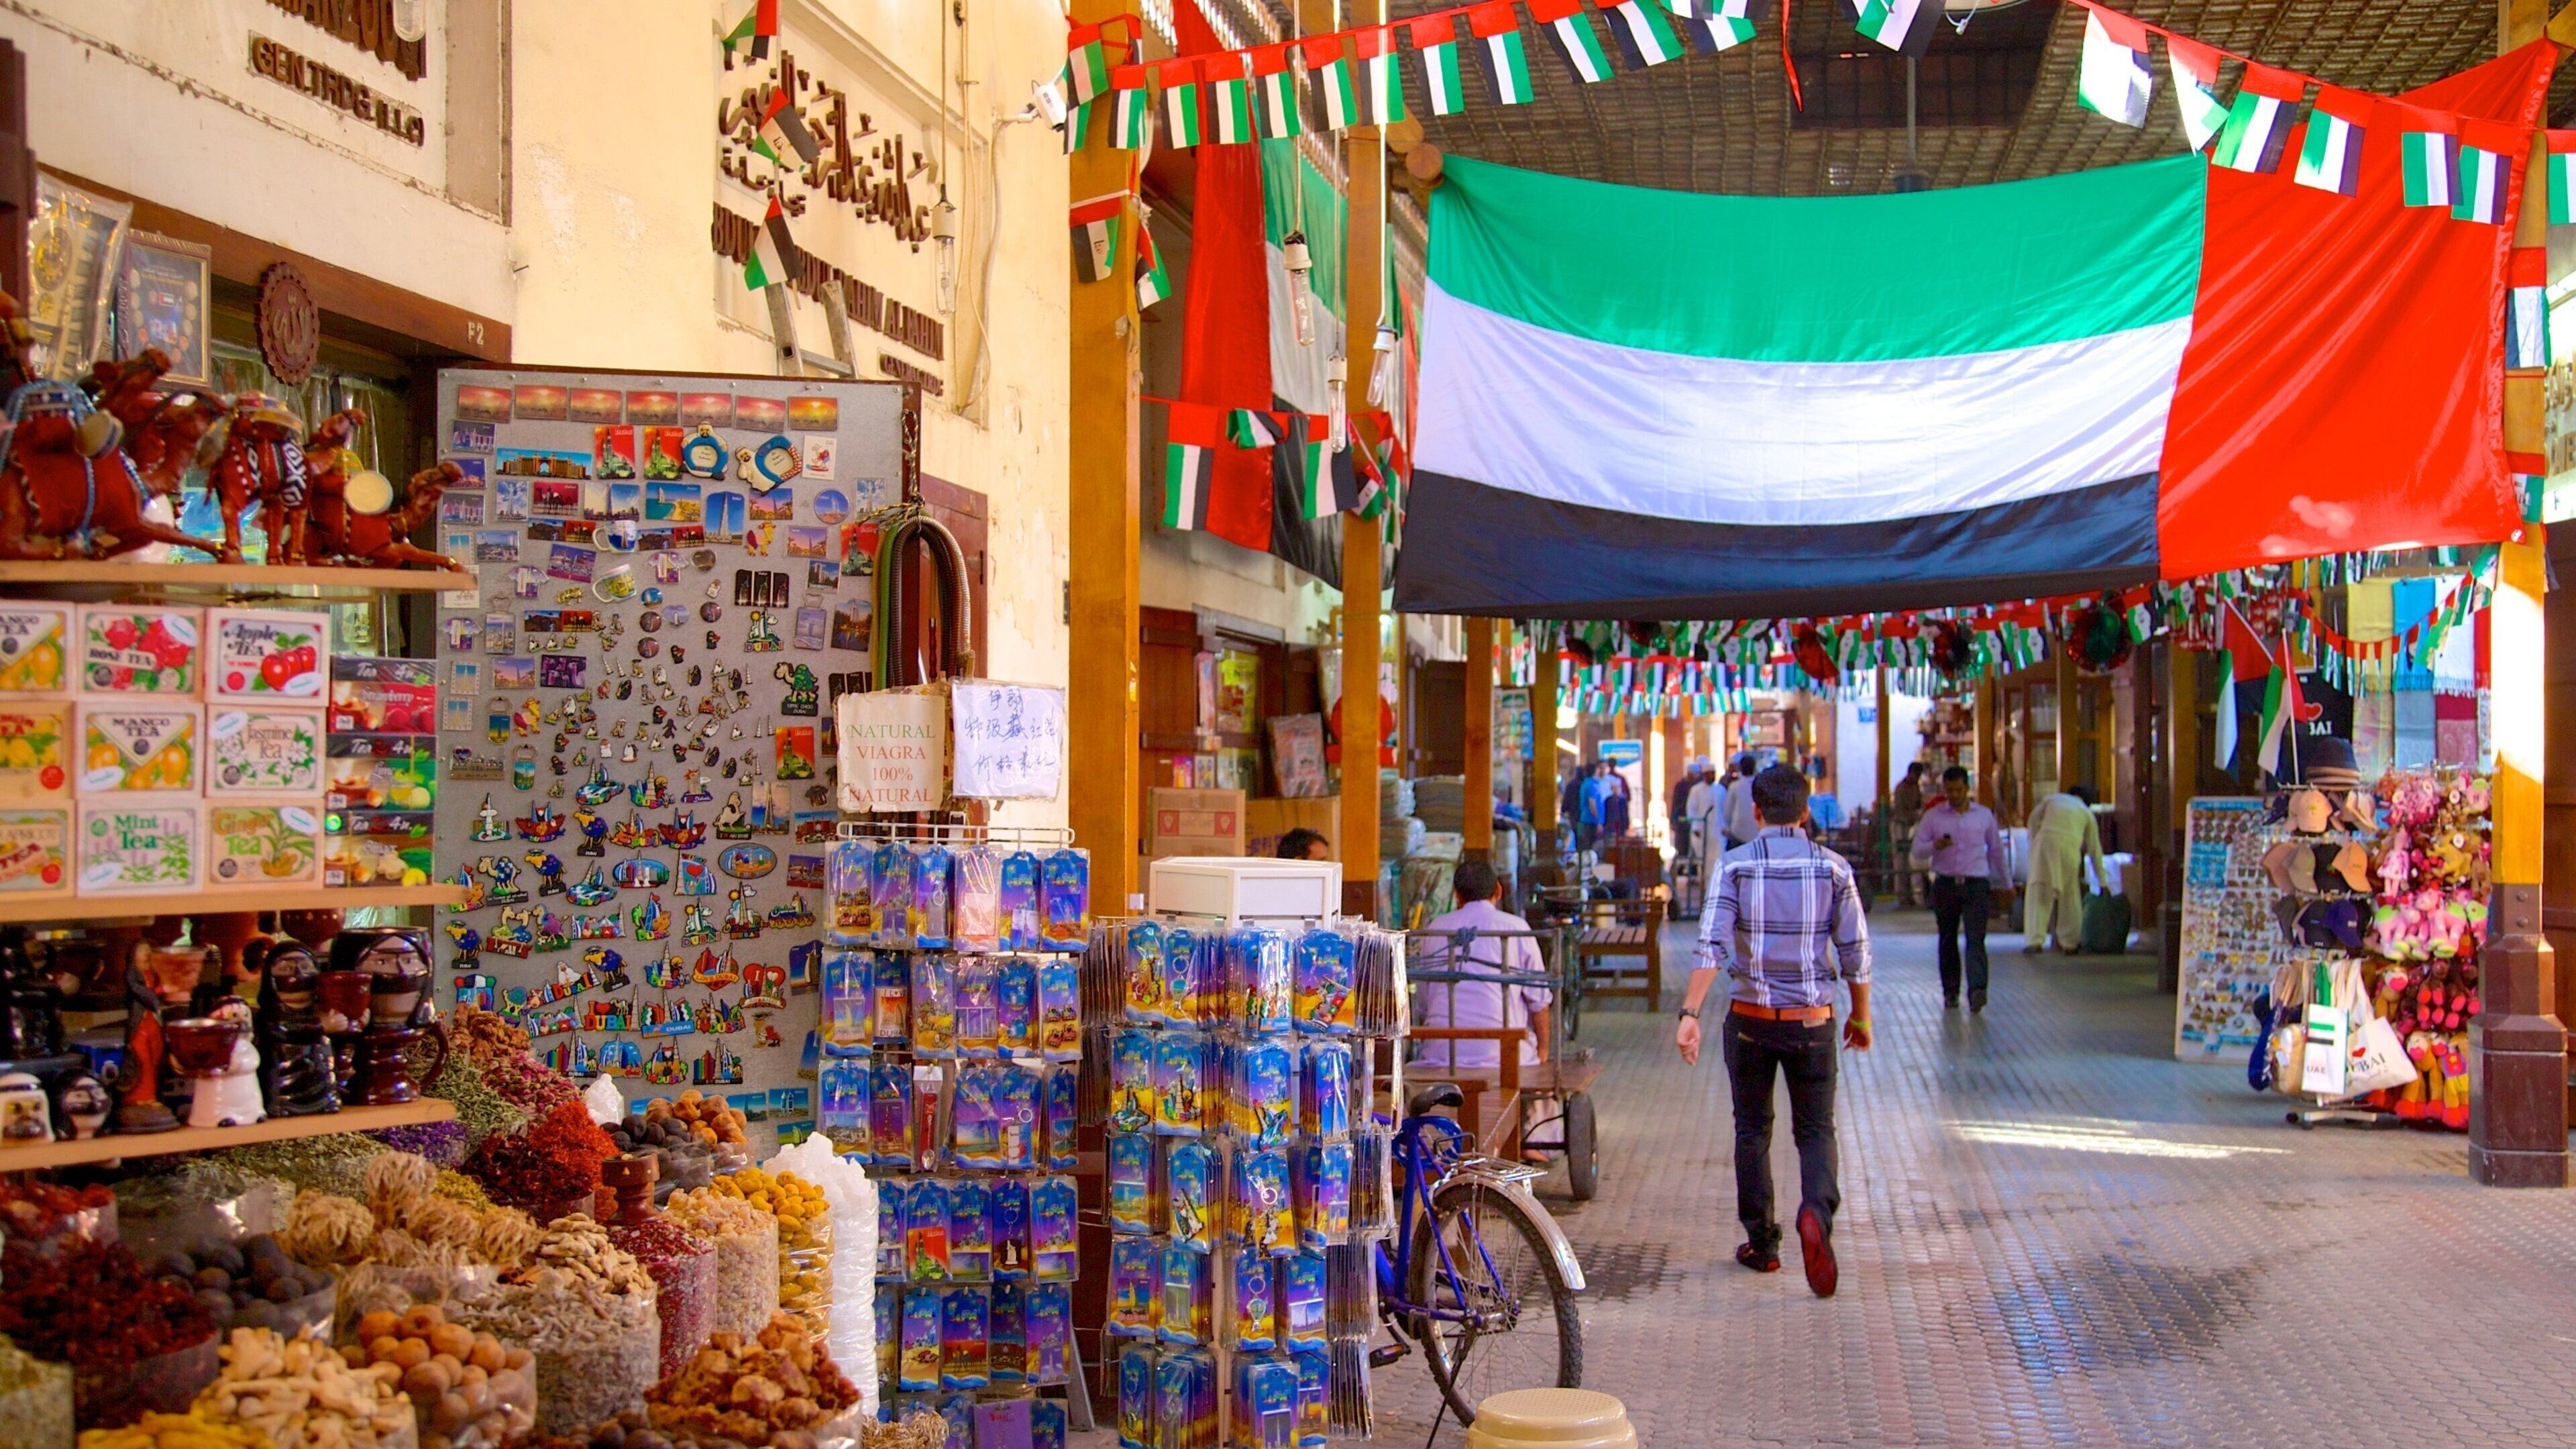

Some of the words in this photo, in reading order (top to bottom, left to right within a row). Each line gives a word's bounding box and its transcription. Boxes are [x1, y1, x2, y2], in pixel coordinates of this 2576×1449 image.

[467, 321, 485, 345] F2
[224, 623, 280, 644] Apple
[745, 641, 784, 652] DUBAI
[89, 648, 121, 661] ROSE
[127, 653, 152, 667] TEA
[360, 687, 415, 706] Strawberry
[989, 688, 1024, 714] 伊朗
[124, 726, 161, 737] TEA
[247, 724, 292, 743] Jasmine
[850, 724, 936, 739] NATURAL
[260, 740, 282, 759] Tea
[856, 745, 926, 760] VIAGRA
[872, 767, 914, 782] 100%
[849, 788, 934, 803] NATURAL
[114, 814, 159, 830] Mint
[120, 830, 158, 850] Tea
[225, 835, 262, 856] Tea
[682, 931, 722, 947] DUBAI
[588, 1000, 596, 1015] I
[584, 1014, 632, 1031] DUBAI
[2306, 1065, 2326, 1074] UAE
